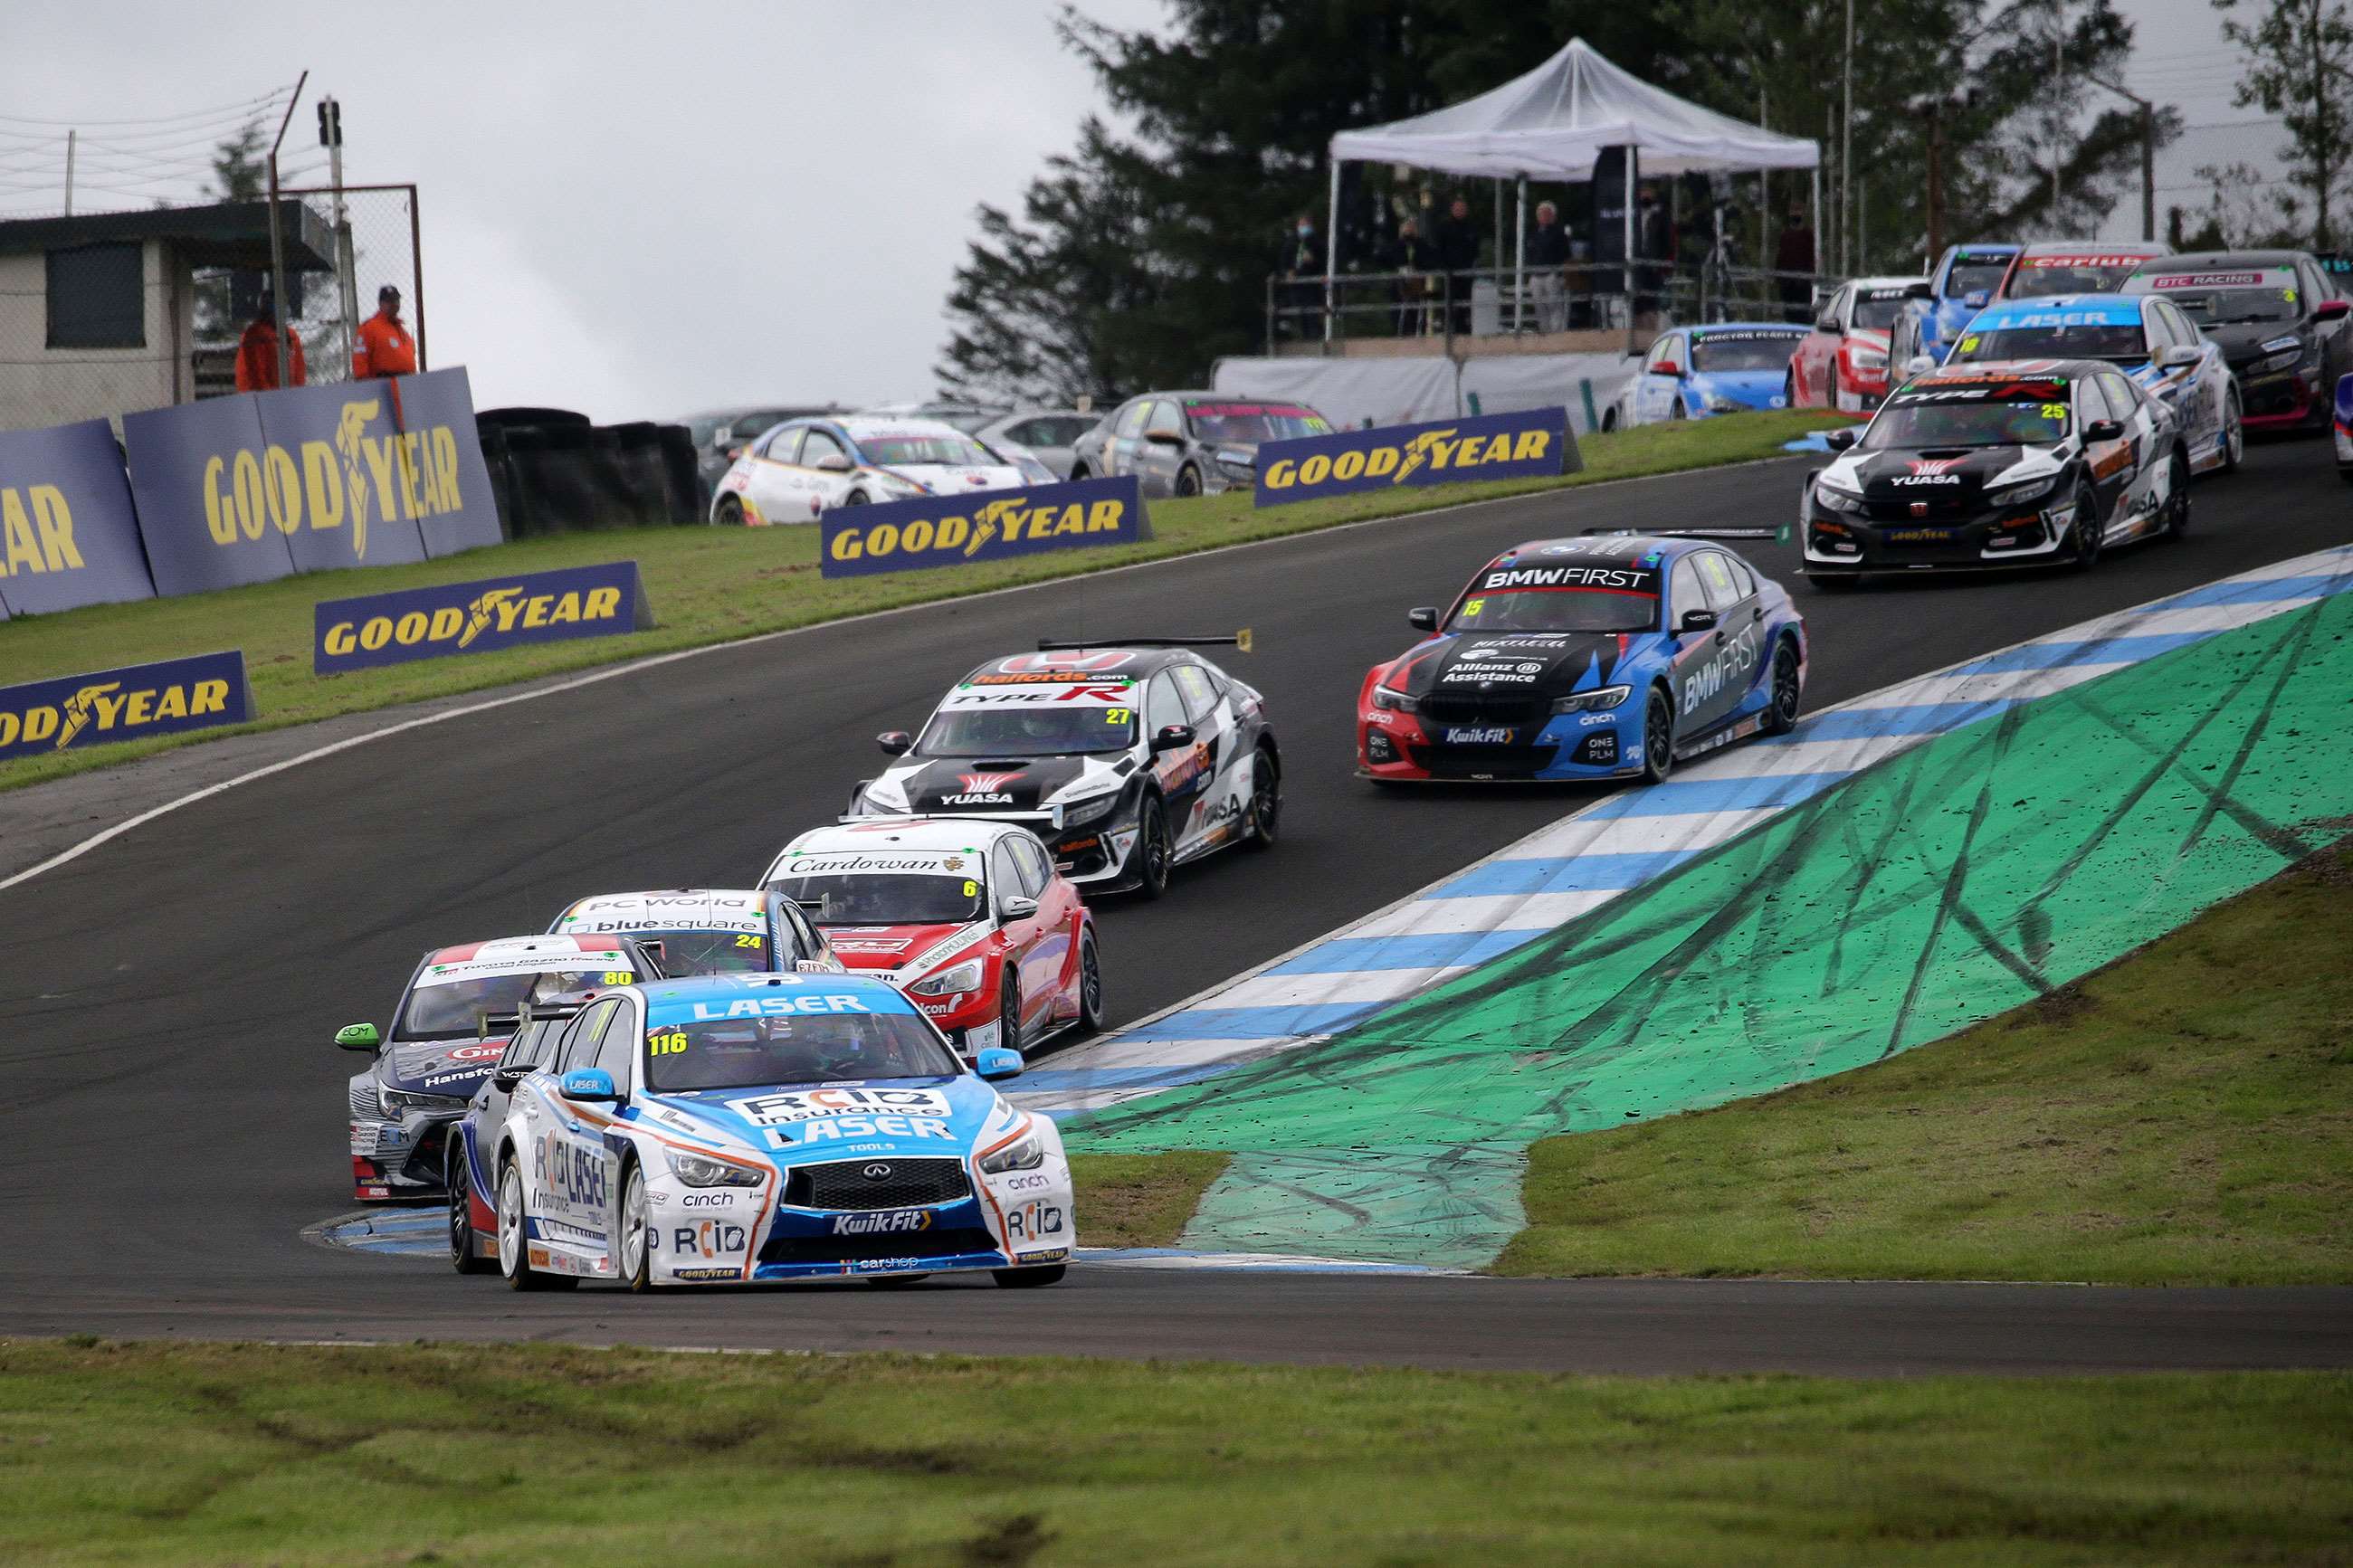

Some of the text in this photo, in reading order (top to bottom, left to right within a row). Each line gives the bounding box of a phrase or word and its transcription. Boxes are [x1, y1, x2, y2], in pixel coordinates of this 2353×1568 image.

[2034, 256, 2142, 268] carlub
[2157, 274, 2254, 289] BTC RACING
[1998, 311, 2107, 329] LASER
[1893, 389, 1990, 404] TYPE
[2041, 404, 2066, 419] 25
[1890, 474, 1961, 487] YUASA
[0, 485, 86, 578] AR
[1462, 599, 1485, 617] 15
[1448, 662, 1515, 672] Allianz
[1442, 672, 1536, 683] Assistance
[951, 685, 1131, 705] TYPE R
[1105, 708, 1130, 725] 27
[1579, 713, 1615, 726] cinch
[1588, 736, 1615, 748] ONE
[1589, 749, 1615, 760] PLM
[940, 793, 1014, 805] YUASA
[789, 856, 939, 873] Cardowan
[962, 880, 977, 898] 6
[735, 934, 761, 949] 24
[462, 960, 515, 971] TOYOTA
[604, 971, 633, 985] 80
[693, 994, 871, 1020] LASER
[919, 1003, 947, 1014] lcon
[342, 1025, 370, 1036] EOM
[648, 1032, 688, 1057] 116
[452, 1045, 506, 1060] GIN
[424, 1067, 494, 1087] Hansfo
[569, 1079, 598, 1090] LASER
[757, 1105, 944, 1126] Insurance
[762, 1116, 958, 1150] LASER
[846, 1143, 896, 1153] TOOLS
[1007, 1173, 1050, 1191] cinch
[682, 1192, 734, 1207] cinch
[859, 1256, 919, 1269] carshop
[679, 1269, 737, 1278] GOODYEAR
